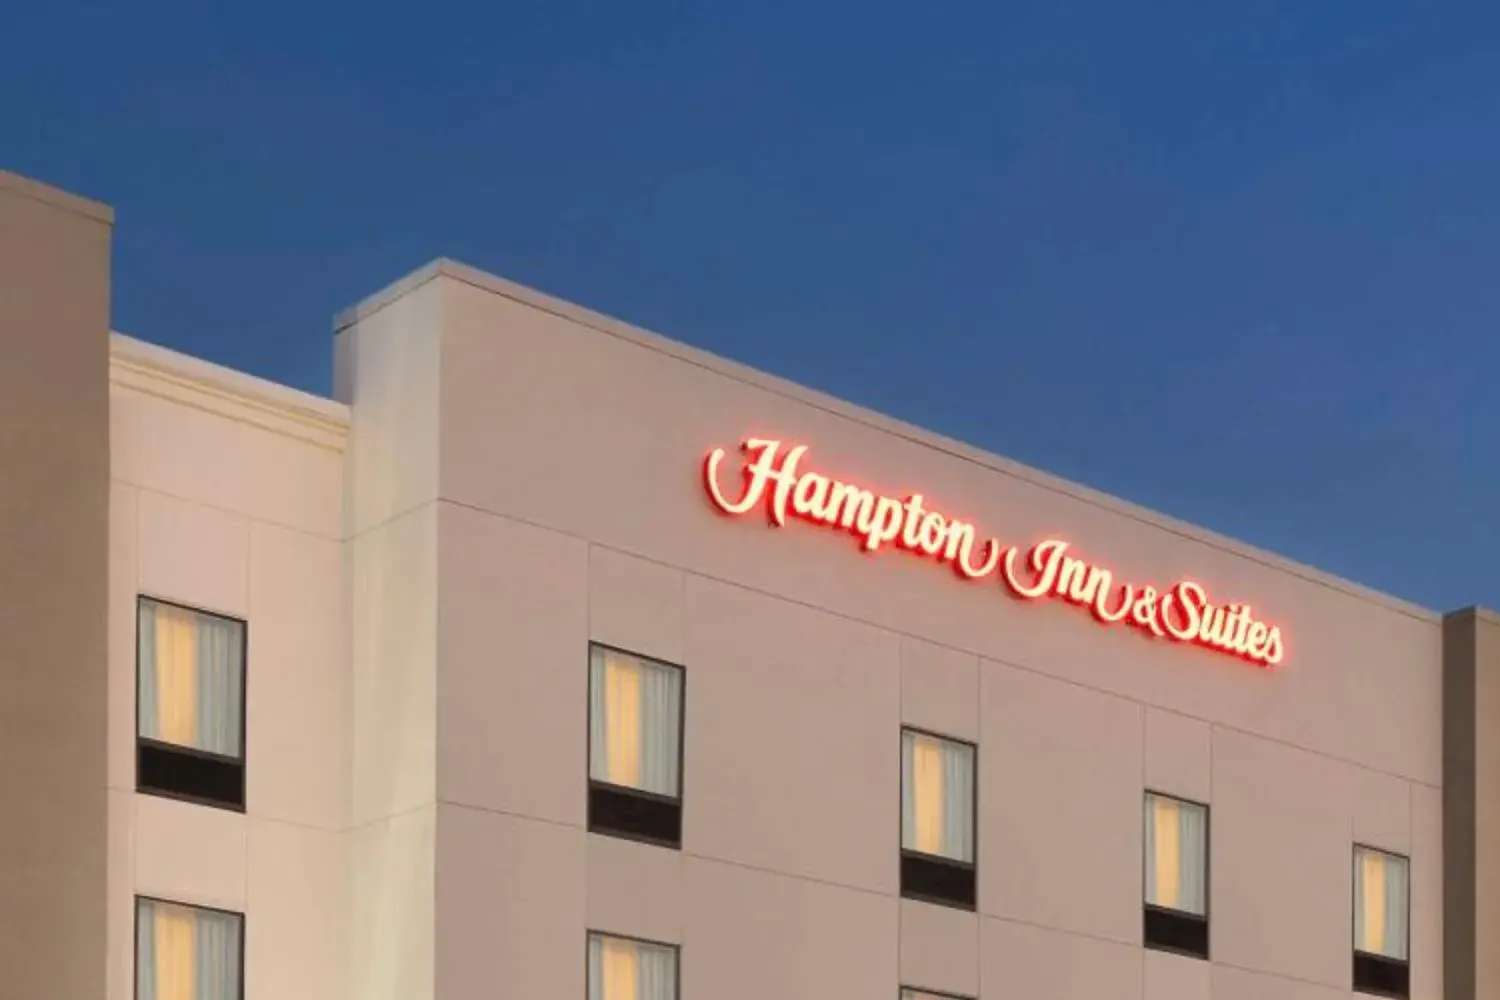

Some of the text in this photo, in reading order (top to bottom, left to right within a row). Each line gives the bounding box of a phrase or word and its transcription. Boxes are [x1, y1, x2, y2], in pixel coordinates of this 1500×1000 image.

[704, 438, 1284, 664] Hampton Inn & Suites
